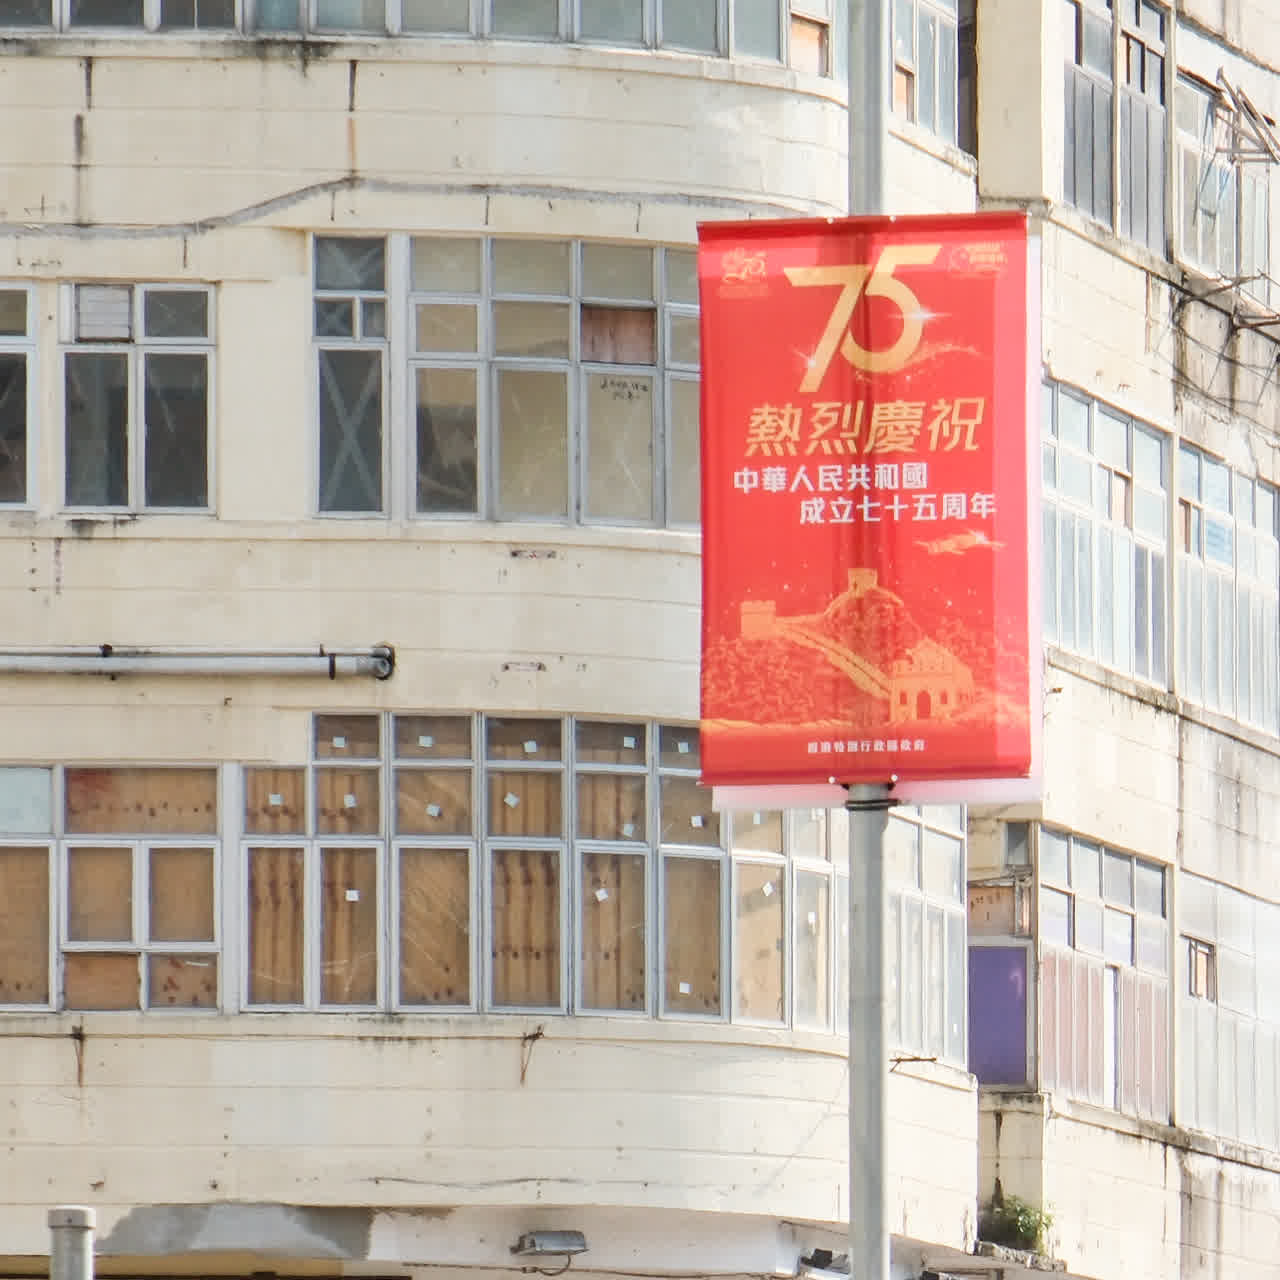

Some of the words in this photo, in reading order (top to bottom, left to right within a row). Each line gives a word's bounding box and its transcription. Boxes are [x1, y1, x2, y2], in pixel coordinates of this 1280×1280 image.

[784, 244, 942, 393] 75
[745, 397, 985, 456] 熱烈慶祝
[733, 462, 928, 493] 中華人民共和國
[799, 493, 996, 524] 成立七十五周年
